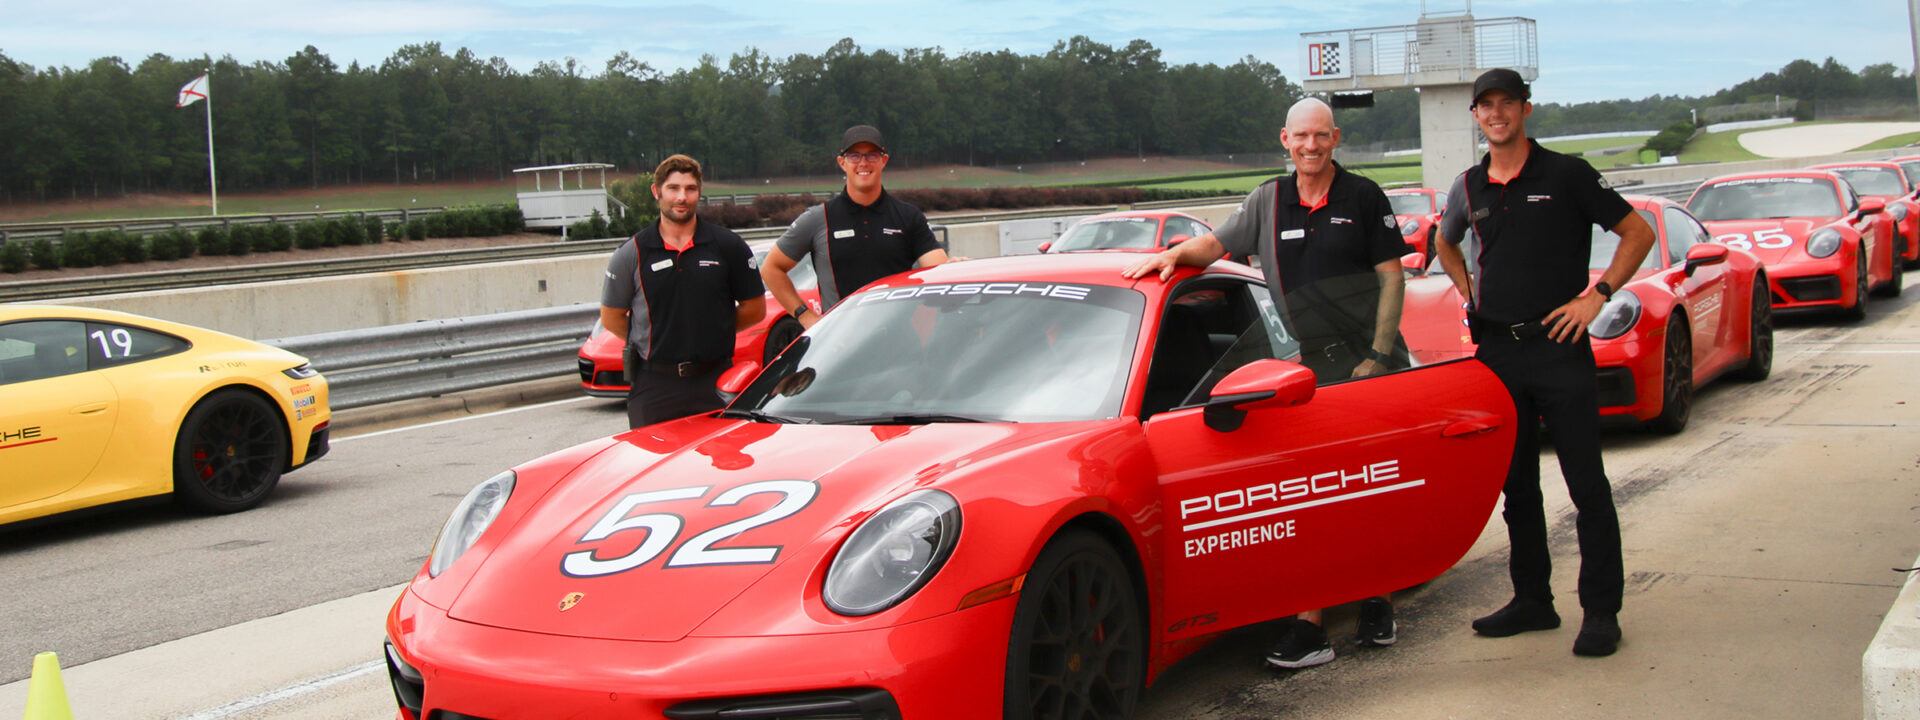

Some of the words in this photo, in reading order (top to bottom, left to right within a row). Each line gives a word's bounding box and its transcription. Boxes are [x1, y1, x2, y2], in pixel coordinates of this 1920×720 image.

[1713, 177, 1813, 188] PORSCHE
[857, 283, 1091, 306] PORSCHE
[1260, 299, 1293, 344] 5
[91, 328, 132, 358] 19
[0, 426, 41, 442] HE
[1180, 459, 1400, 520] PORSCHE
[560, 479, 820, 579] 52
[1184, 520, 1296, 558] EXPERIENCE
[1168, 612, 1219, 632] GTS
